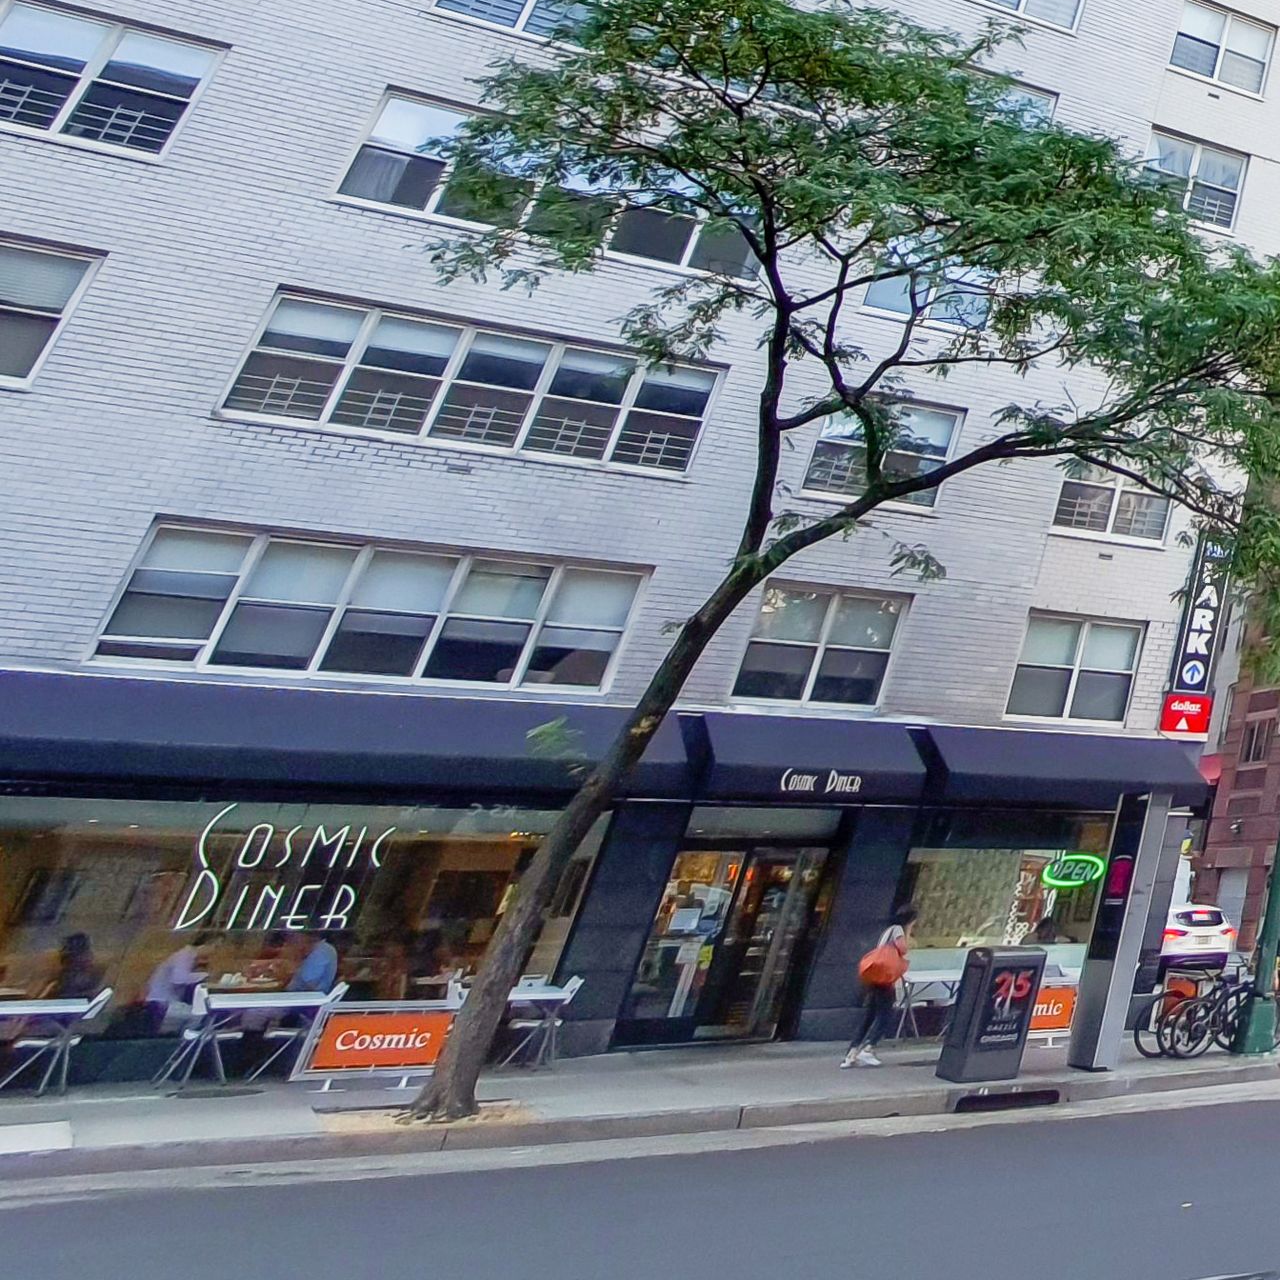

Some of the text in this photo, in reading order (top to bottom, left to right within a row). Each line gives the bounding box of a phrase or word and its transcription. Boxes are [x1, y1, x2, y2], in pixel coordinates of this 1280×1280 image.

[1171, 698, 1202, 712] dollar
[199, 803, 396, 868] COSMIC
[1053, 861, 1098, 882] OPEN
[174, 869, 356, 930] DINER
[1032, 999, 1063, 1017] mic
[335, 1027, 431, 1051] Cosmic
